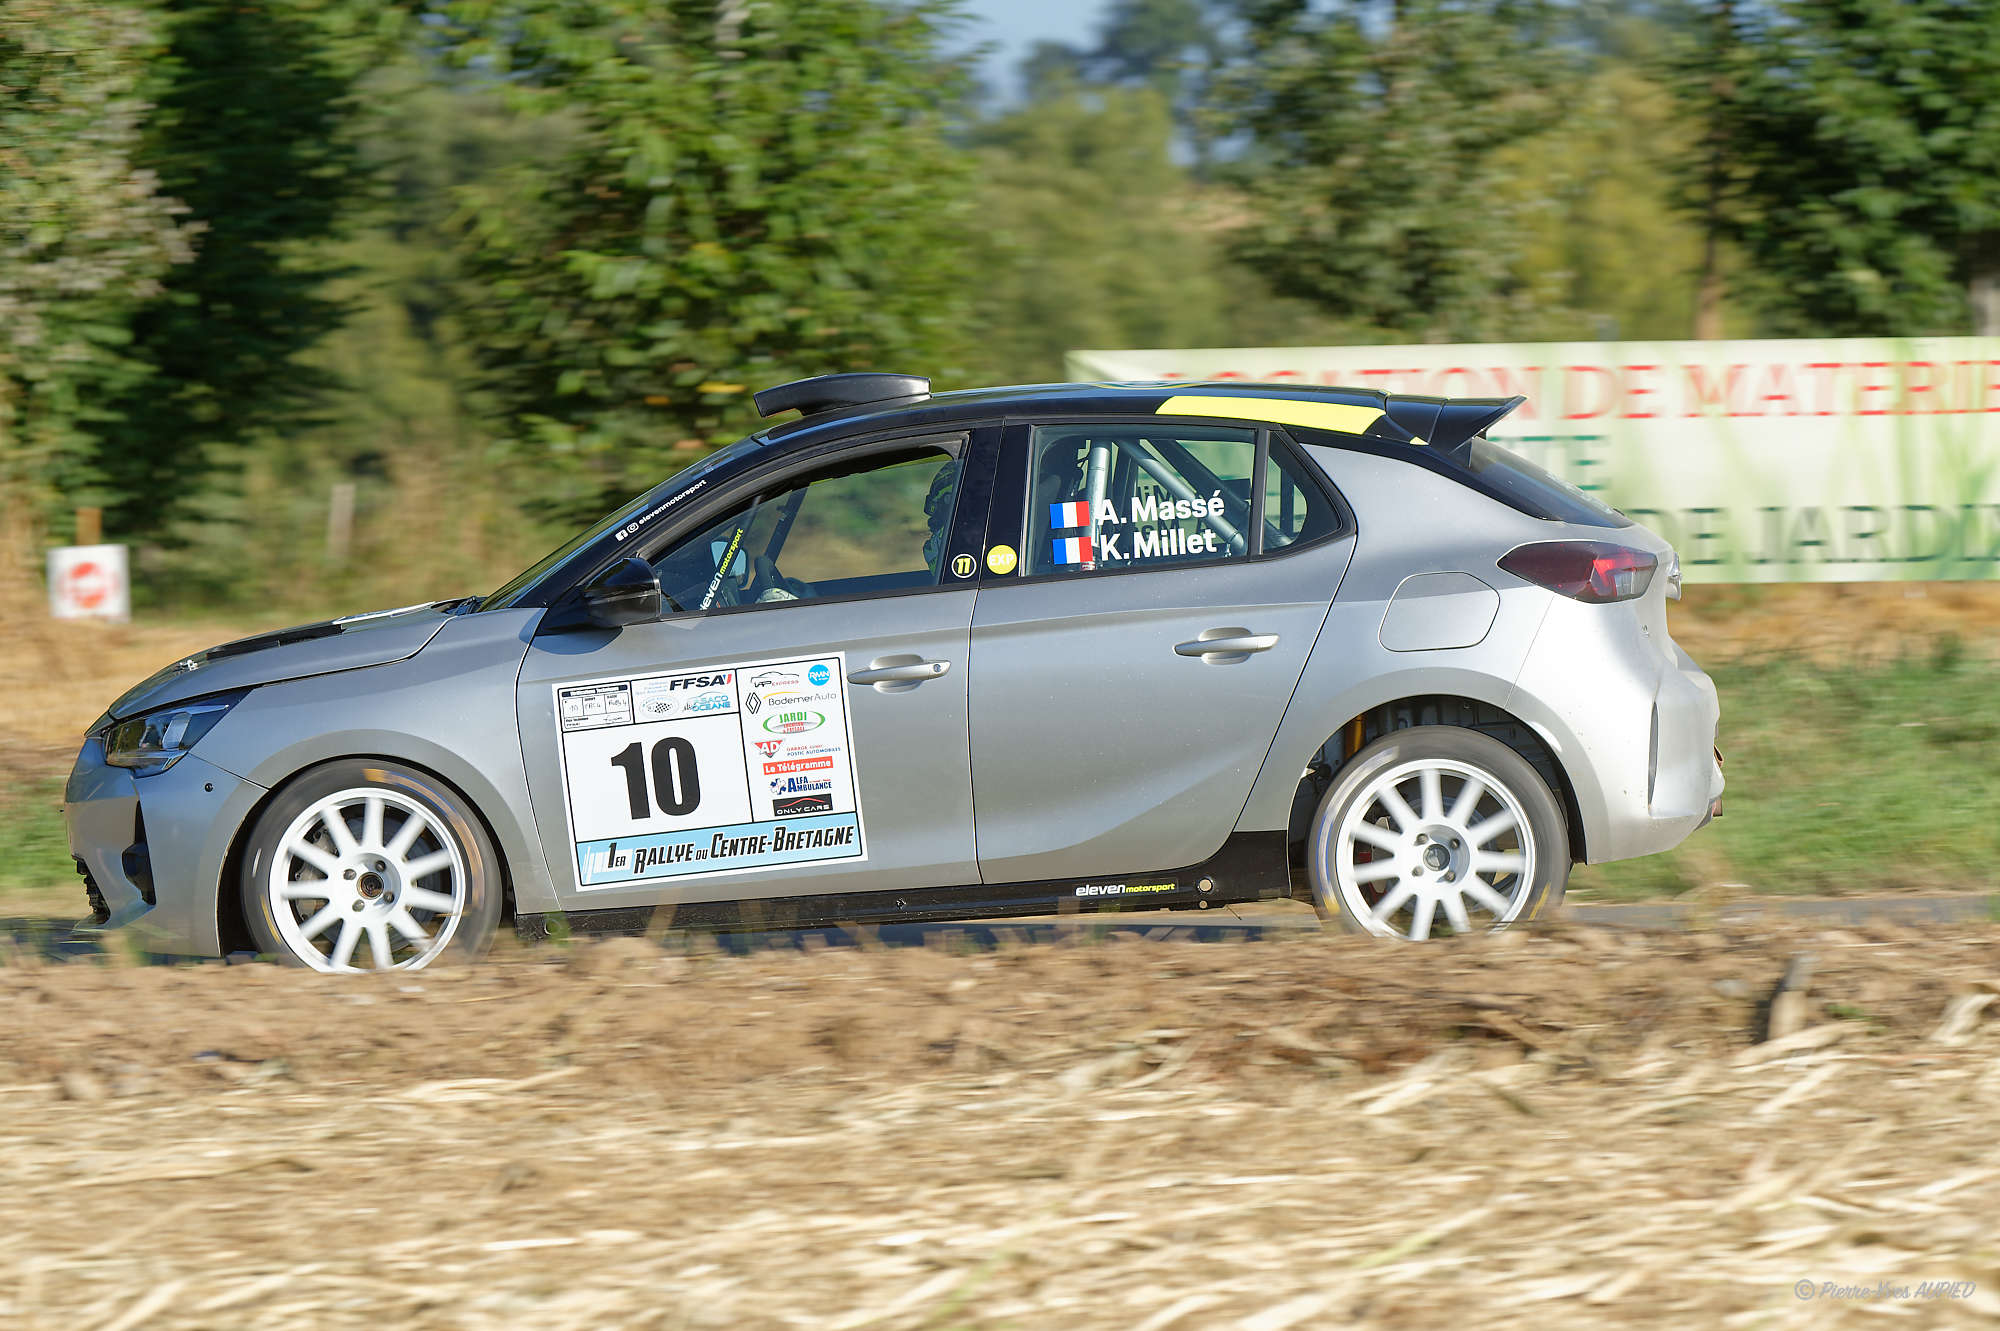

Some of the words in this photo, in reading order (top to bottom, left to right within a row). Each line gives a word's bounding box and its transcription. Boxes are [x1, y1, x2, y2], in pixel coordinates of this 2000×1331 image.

[1560, 365, 1664, 420] DE
[639, 479, 707, 525] elevenmotorsport
[1131, 489, 1225, 523] Massé
[719, 528, 744, 575] motorsport
[1133, 527, 1217, 559] Millet
[988, 553, 1015, 567] EXP
[669, 674, 725, 691] FFSA
[768, 692, 837, 706] BodemerAuto
[779, 711, 807, 723] JARDI
[760, 741, 780, 753] AD
[765, 765, 776, 773] Le
[777, 760, 831, 772] Télégramme
[611, 736, 701, 821] 10
[776, 806, 802, 815] ONLY
[803, 804, 830, 812] CARS
[633, 843, 695, 874] RALLYE
[710, 825, 855, 859] CENTRE-BRETAGNE
[1075, 884, 1126, 897] eleven
[1125, 883, 1176, 894] motorsport
